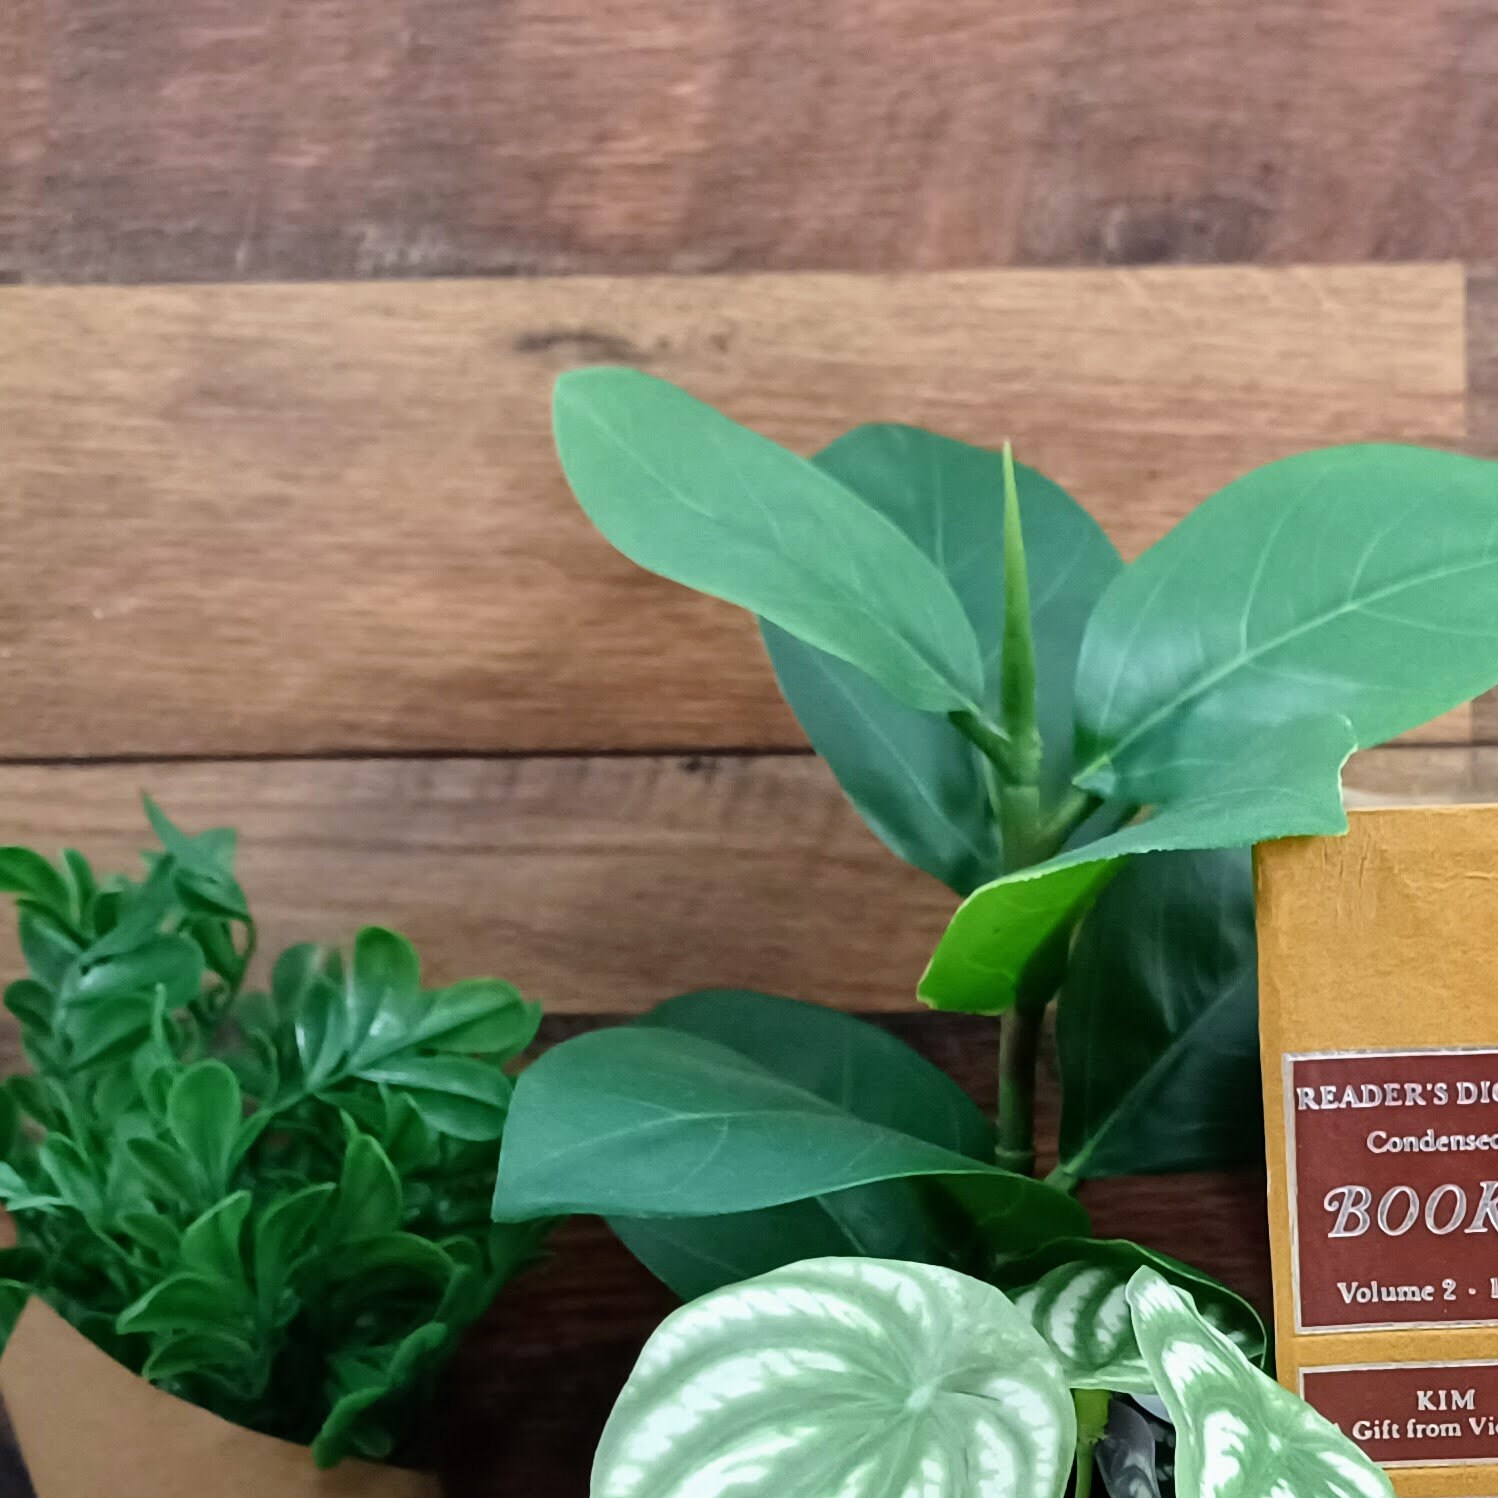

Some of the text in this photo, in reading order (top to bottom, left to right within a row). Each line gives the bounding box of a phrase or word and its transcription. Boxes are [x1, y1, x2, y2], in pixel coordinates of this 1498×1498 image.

[1296, 1082, 1449, 1110] READER'S
[1337, 1280, 1435, 1304] Volume
[1442, 1278, 1457, 1300] 2
[1416, 1389, 1476, 1411] KIM
[1352, 1420, 1400, 1440] Gift
[1406, 1418, 1462, 1439] from
